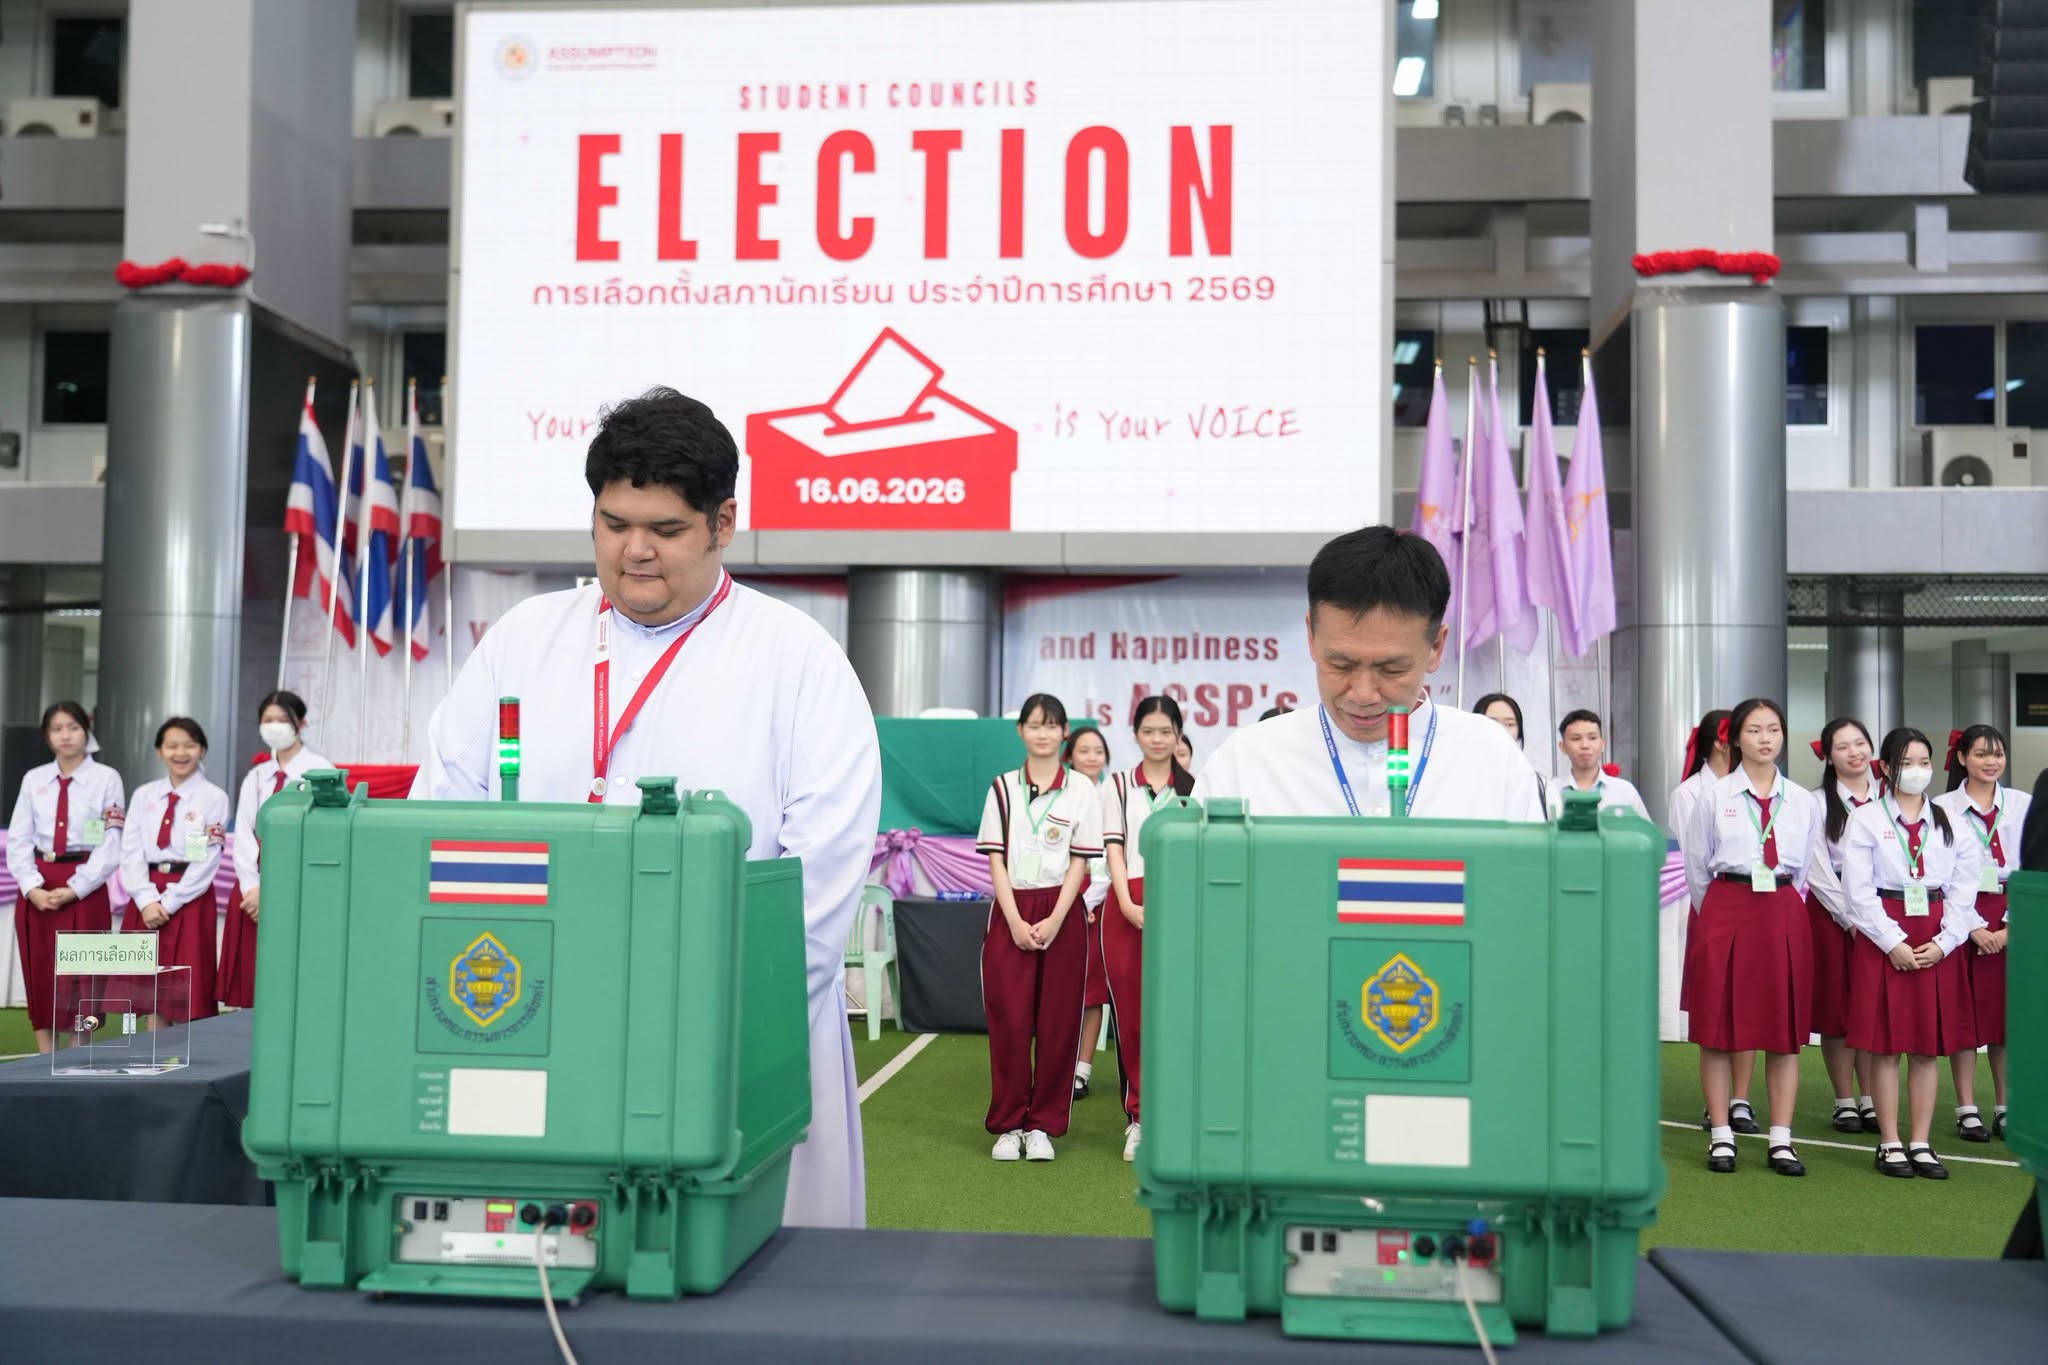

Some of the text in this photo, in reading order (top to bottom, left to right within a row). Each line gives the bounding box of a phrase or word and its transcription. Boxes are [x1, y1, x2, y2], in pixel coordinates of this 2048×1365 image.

[740, 81, 1037, 110] STUDENT COUNCILS
[576, 125, 1233, 262] ELECTION
[534, 269, 1275, 305] การเลือกตั้งสภานักเรียน ประจำปีการศึกษา 2569
[527, 402, 1304, 443] Your is Your VOICE
[795, 477, 966, 504] 16.06.2026
[1040, 632, 1279, 664] and Happiness
[1085, 697, 1112, 727] is
[59, 940, 153, 962] ผลการเลือกตั้ง
